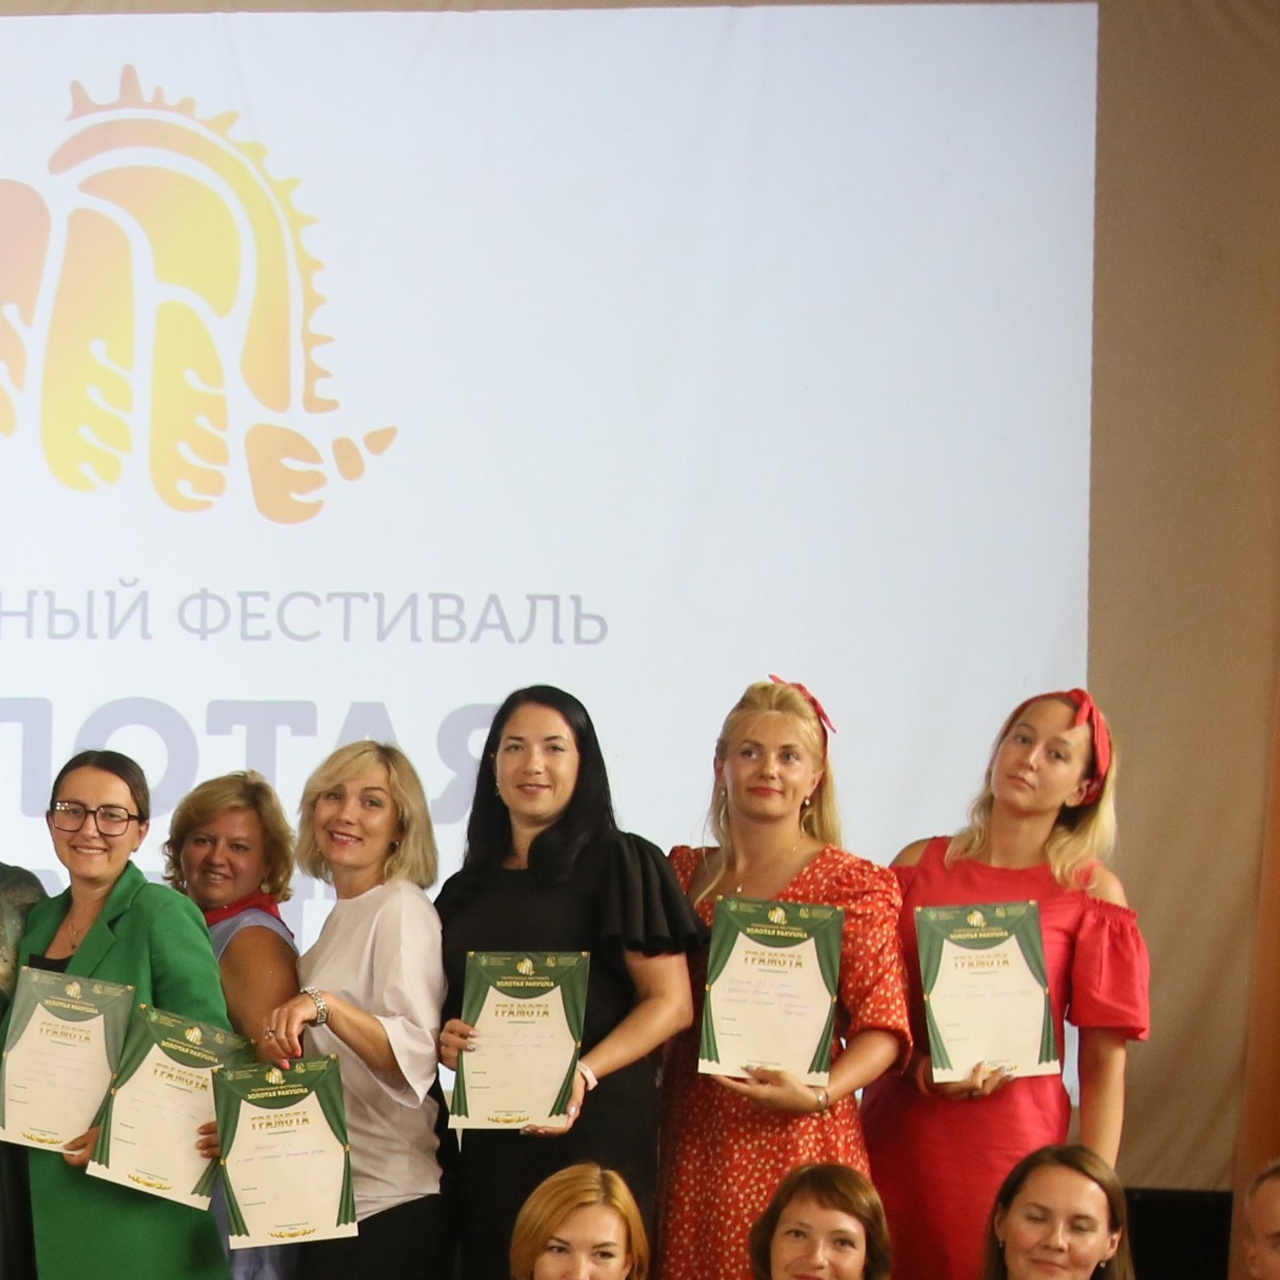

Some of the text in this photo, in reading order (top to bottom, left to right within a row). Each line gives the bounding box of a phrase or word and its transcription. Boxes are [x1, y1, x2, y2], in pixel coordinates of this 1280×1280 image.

[176, 588, 608, 646] ФЕСТИВАЛЬ
[744, 949, 803, 968] ГРАМОТА
[953, 953, 1010, 970] ГРАМОТА
[494, 1003, 549, 1018] ГРАМОТА
[153, 1062, 209, 1090] ГРАМОТА
[251, 1111, 311, 1131] ГРАМОТА
